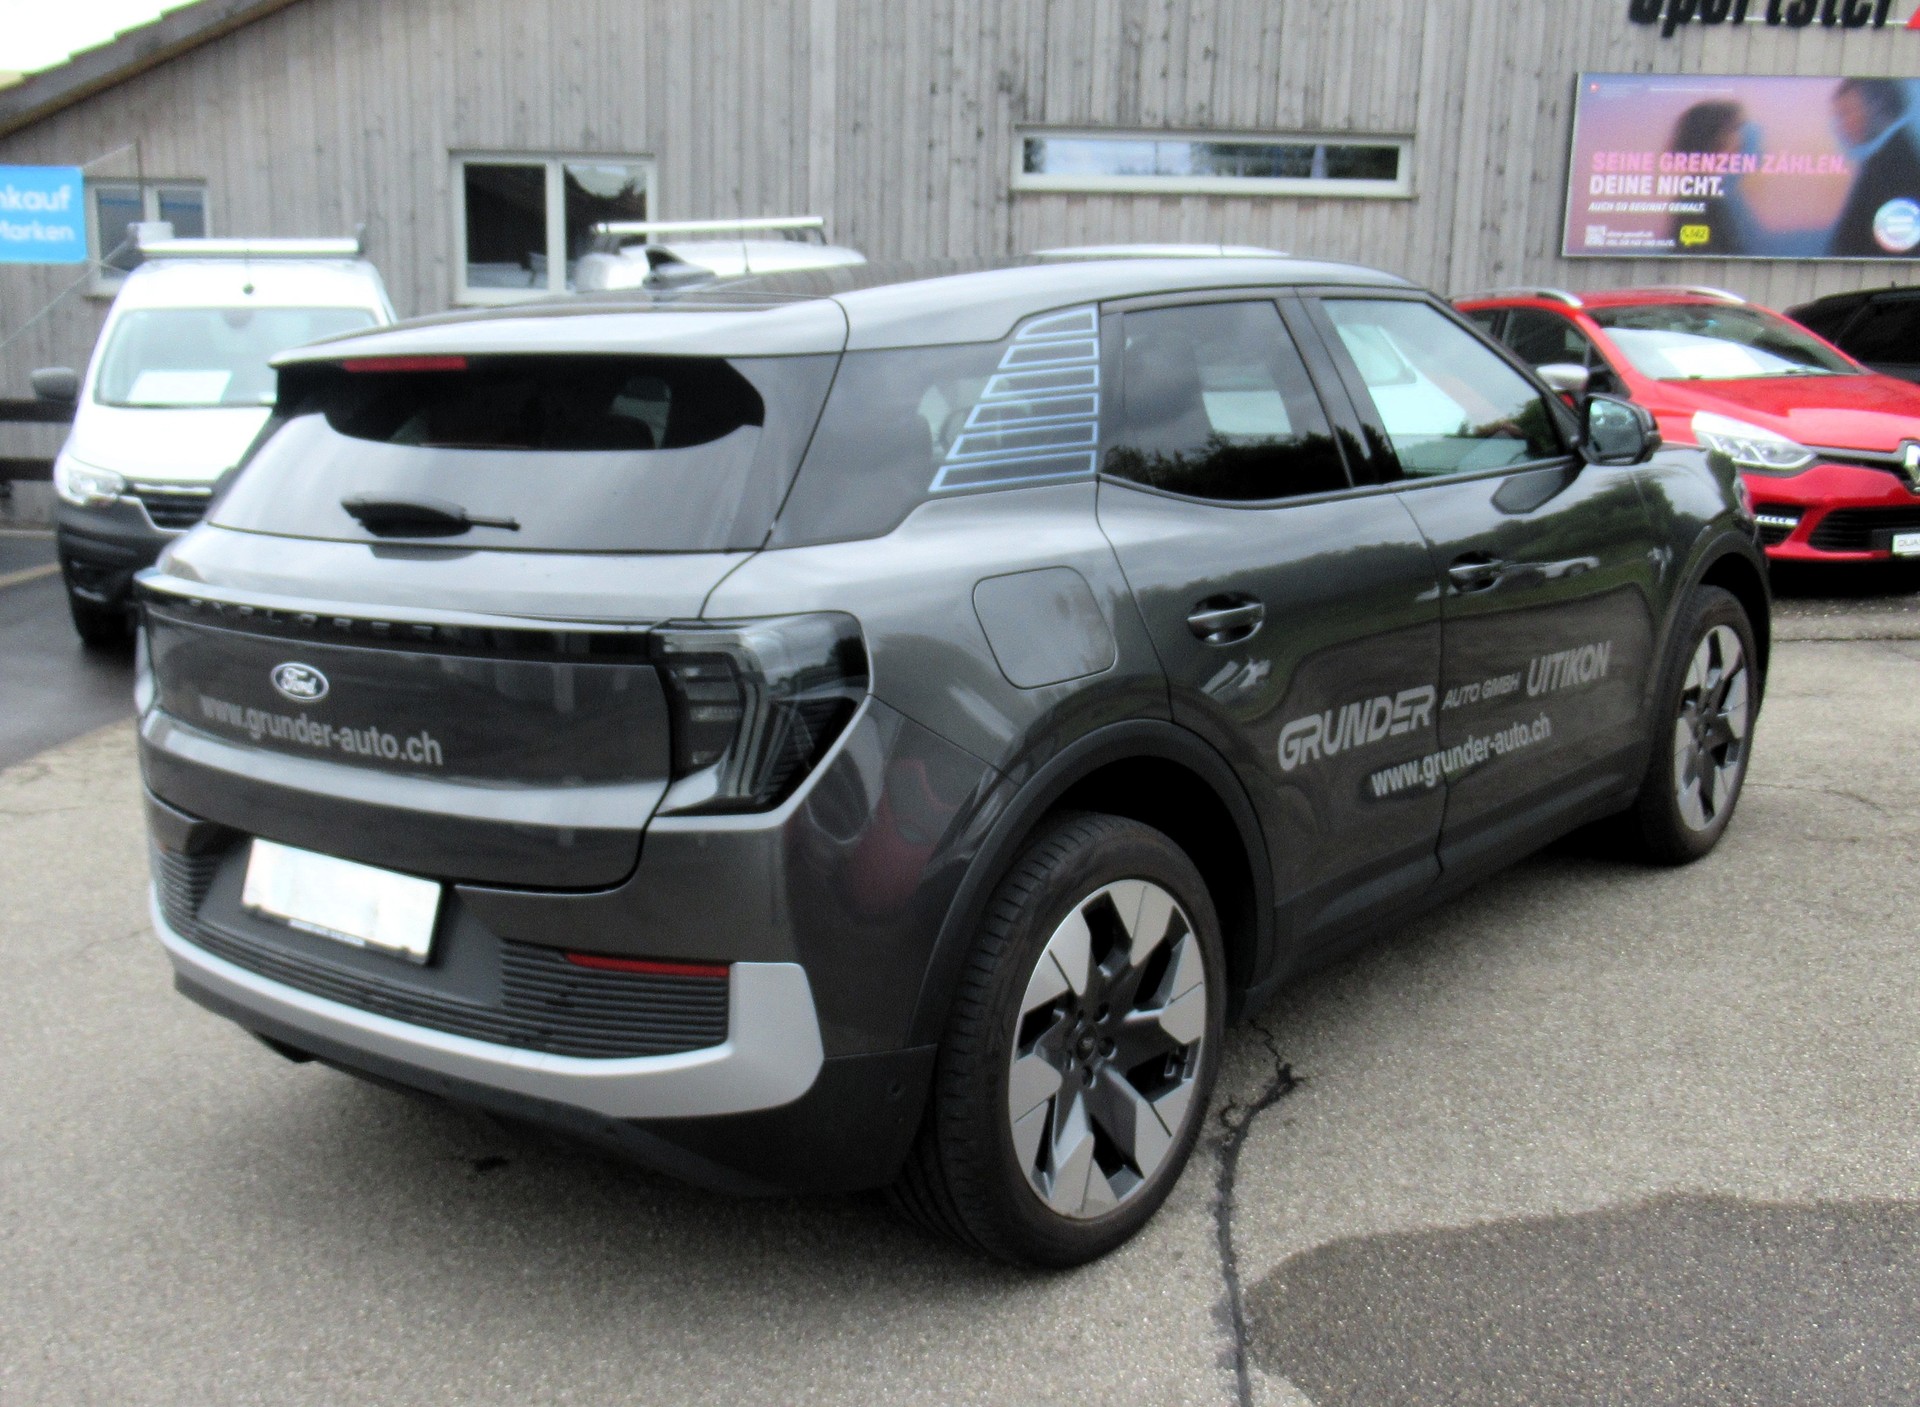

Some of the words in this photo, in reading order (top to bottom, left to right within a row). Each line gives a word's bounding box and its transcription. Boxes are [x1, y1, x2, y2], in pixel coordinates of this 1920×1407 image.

[1589, 175, 1653, 196] DEINE
[1657, 175, 1725, 197] NICHT.
[1592, 153, 1655, 173] SEINE
[1660, 153, 1757, 174] GRENZEN
[199, 695, 443, 767] www.grunder-auto.ch
[1278, 685, 1437, 772] GRUNDER
[1441, 682, 1480, 711] AUTO
[1371, 711, 1551, 797] www.grunder-auto.ch
